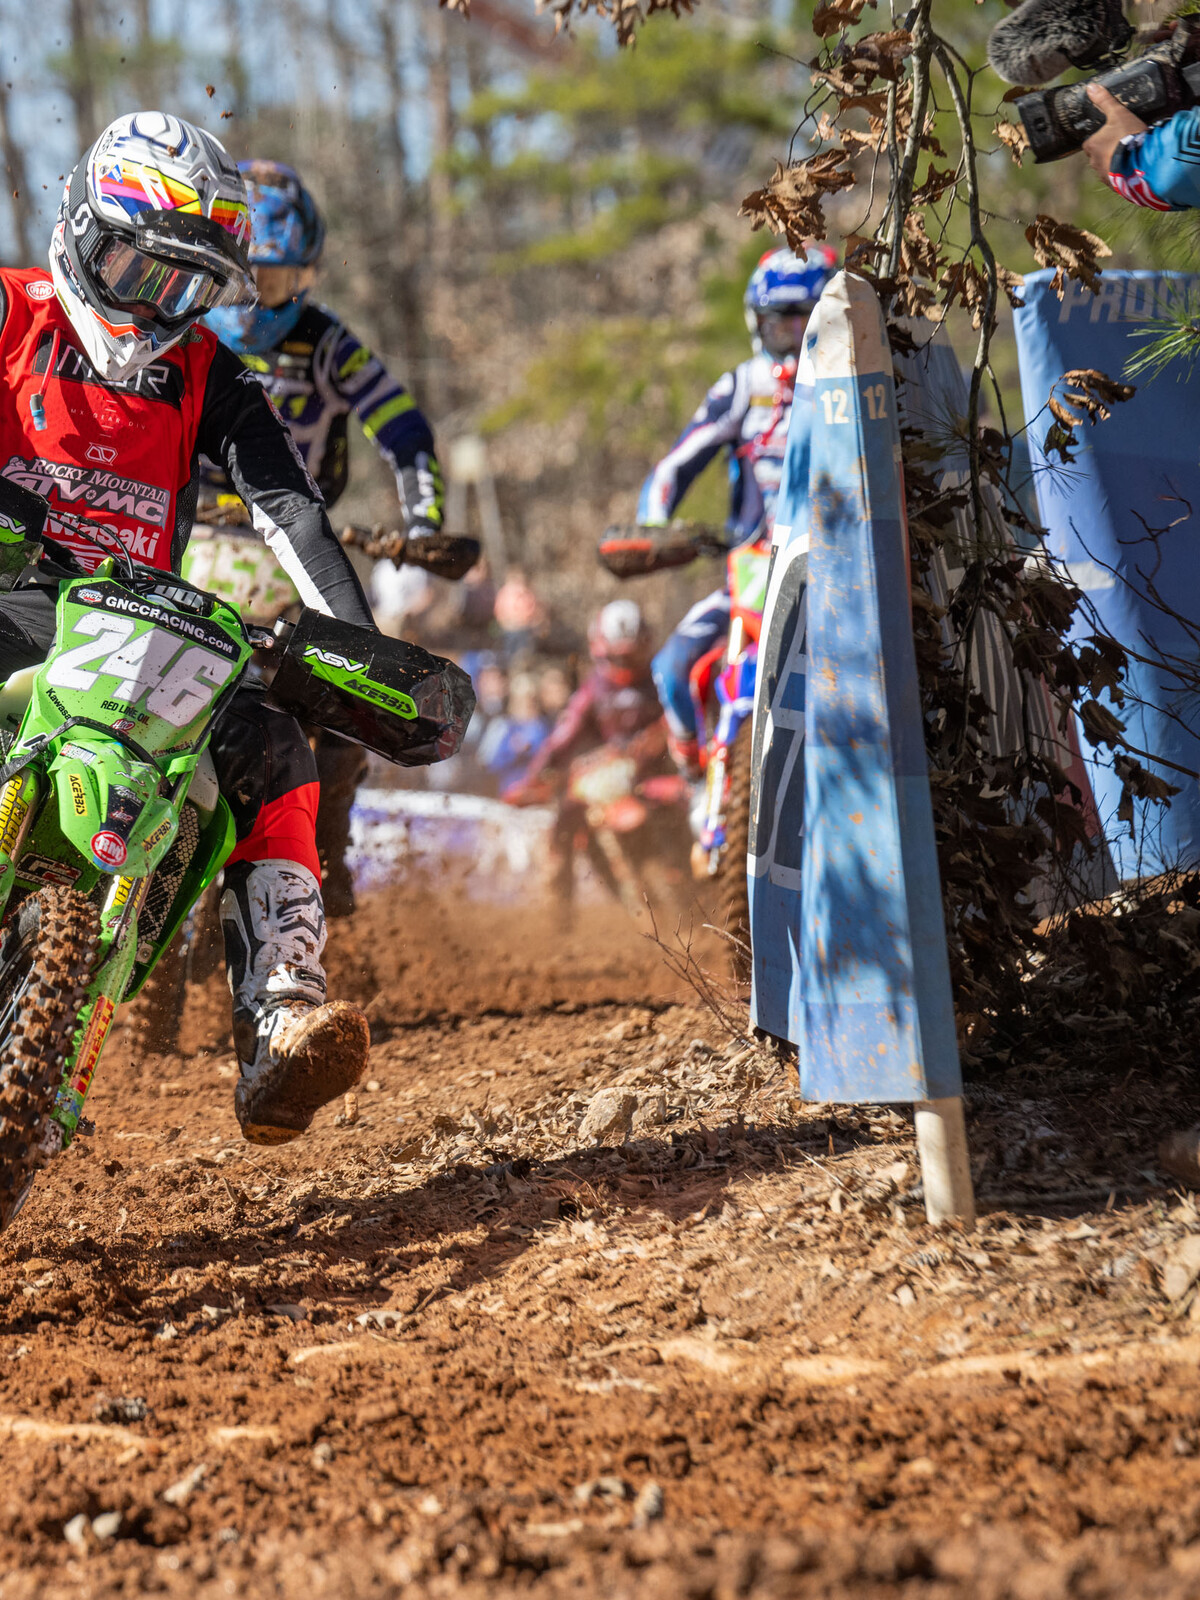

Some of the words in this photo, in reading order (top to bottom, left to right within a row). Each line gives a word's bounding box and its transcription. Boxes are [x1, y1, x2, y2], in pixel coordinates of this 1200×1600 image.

[1058, 277, 1200, 323] PROG
[57, 345, 169, 395] MR
[820, 388, 850, 425] 12
[862, 383, 888, 420] 12
[92, 412, 121, 424] GEAR
[128, 420, 147, 430] DIV
[30, 459, 88, 482] ROCKY
[87, 470, 169, 504] MOUNTAIN
[46, 610, 234, 729] 246
[46, 688, 72, 720] Kawasa
[100, 700, 119, 712] RED
[119, 704, 138, 718] LINE
[137, 713, 150, 726] OIL
[69, 775, 86, 815] ACERBIS
